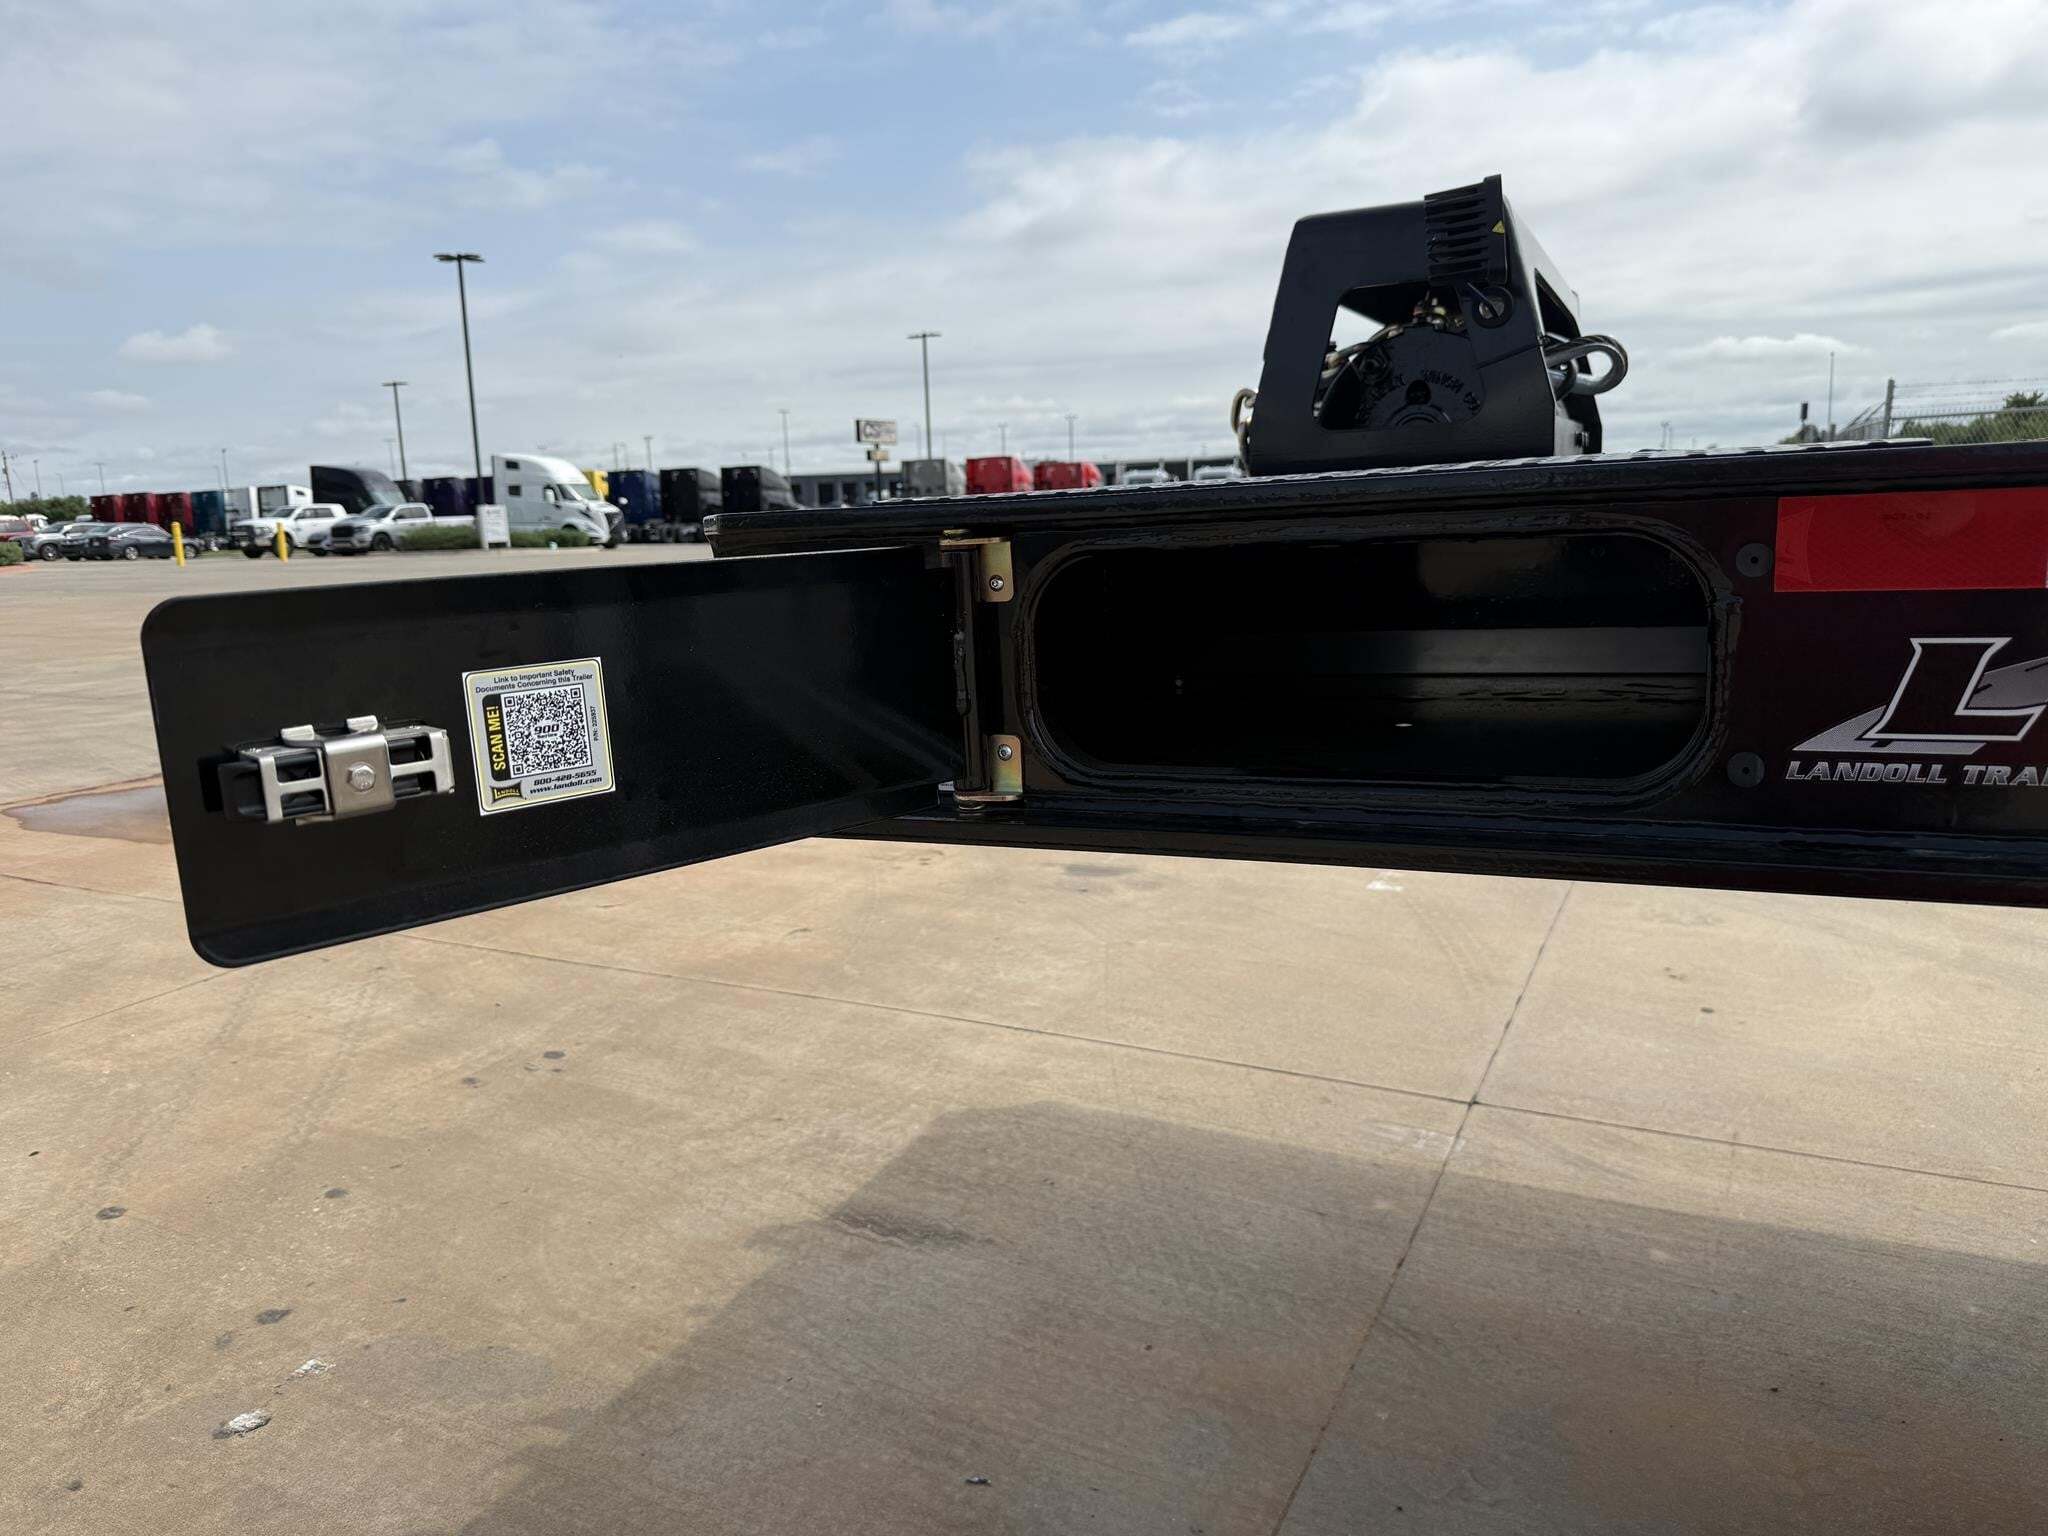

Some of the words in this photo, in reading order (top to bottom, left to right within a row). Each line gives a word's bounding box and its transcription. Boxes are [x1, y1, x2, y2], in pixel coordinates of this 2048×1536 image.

[475, 683, 516, 693] Documents
[517, 678, 557, 688] Concerning
[571, 673, 593, 681] Trailer
[493, 675, 509, 684] Link
[510, 674, 518, 682] to
[519, 671, 553, 681] Important
[553, 668, 575, 678] Safety
[486, 705, 502, 733] ME!
[534, 723, 560, 734] 900
[490, 733, 506, 771] SCAN
[1785, 761, 1948, 784] LANDOLL
[529, 776, 603, 794] www.landoll.com
